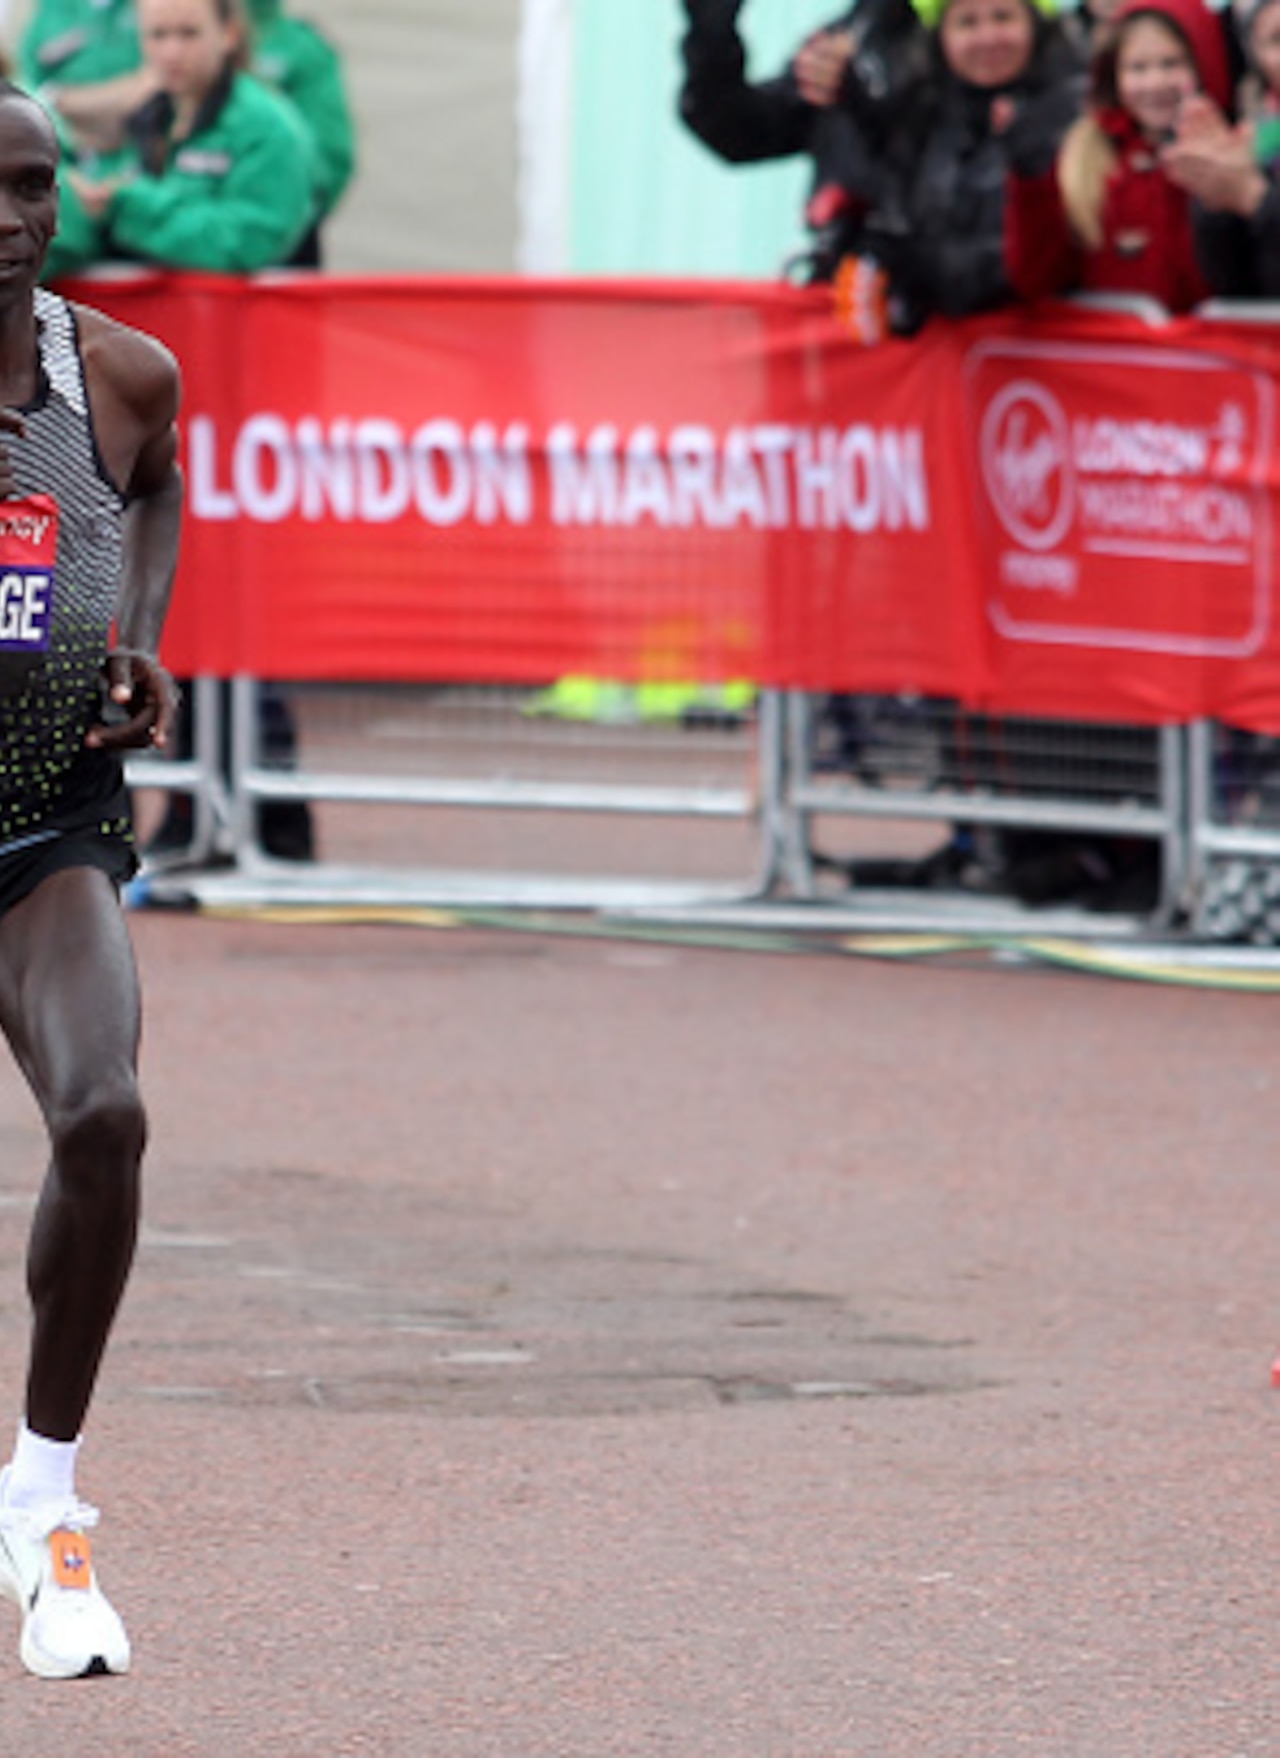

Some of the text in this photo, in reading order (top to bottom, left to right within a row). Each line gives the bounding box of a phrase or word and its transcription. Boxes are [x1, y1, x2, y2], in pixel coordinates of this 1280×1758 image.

[189, 412, 533, 526] LONDON
[545, 420, 930, 533] MARATHON
[1073, 415, 1207, 476] LONDON
